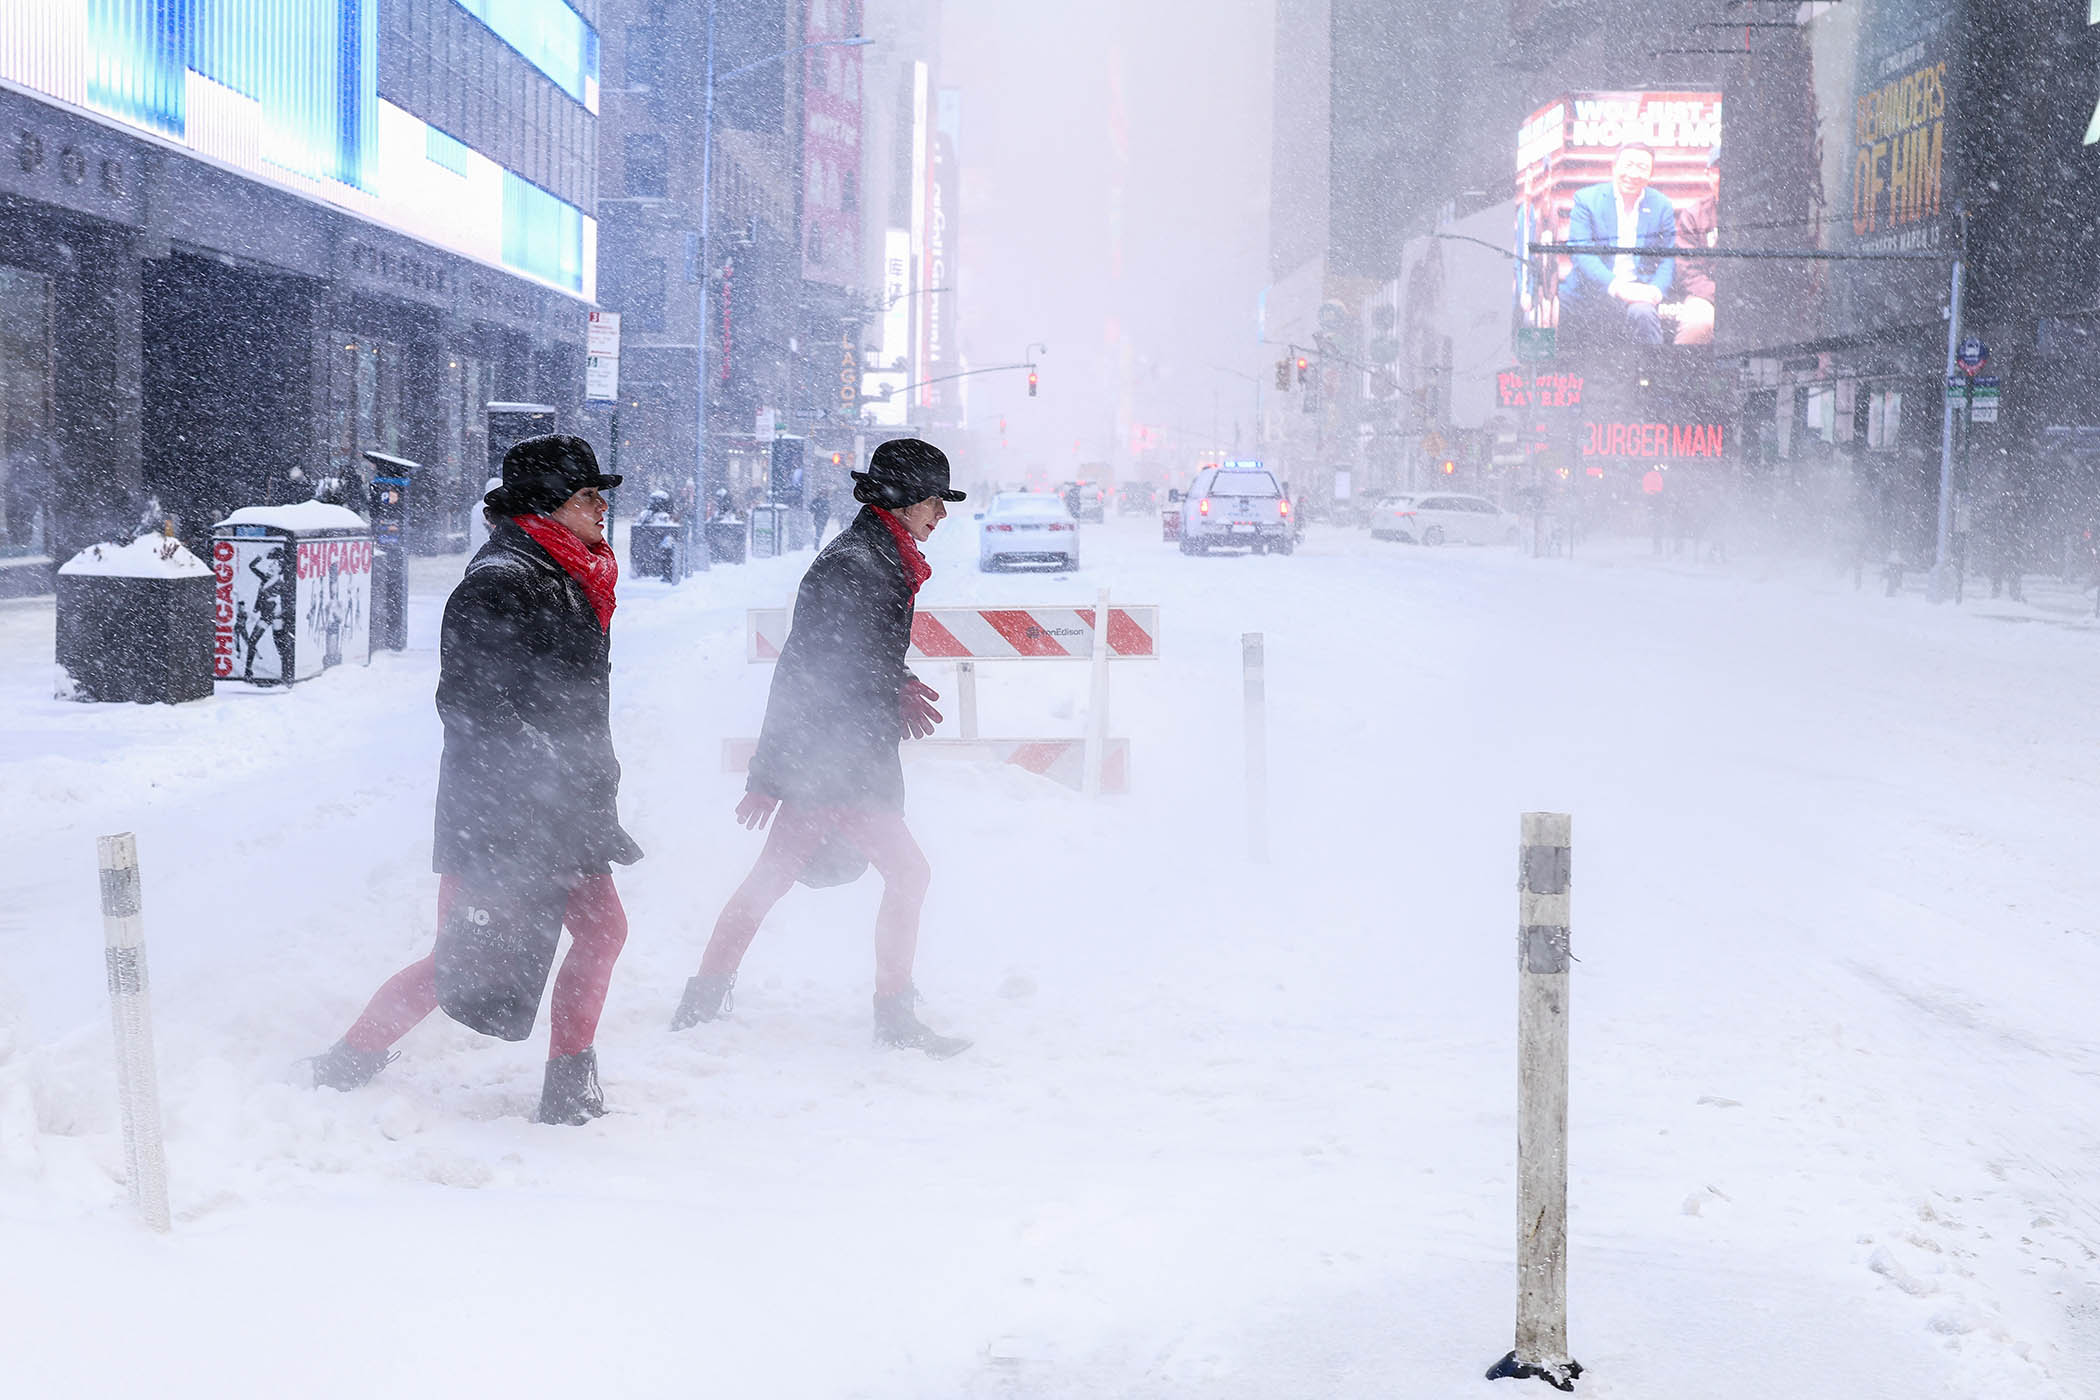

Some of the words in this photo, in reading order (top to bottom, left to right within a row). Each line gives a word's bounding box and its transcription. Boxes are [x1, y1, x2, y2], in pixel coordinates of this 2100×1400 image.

[1855, 60, 1947, 146] REMINDERS
[1853, 141, 1888, 236] OF
[1889, 120, 1945, 227] HIM
[1497, 371, 1584, 395] Plawright
[1583, 423, 1668, 456] BURGER
[1671, 423, 1723, 457] MAN
[297, 541, 373, 579] CHICAGO
[213, 541, 235, 677] CHICAGO
